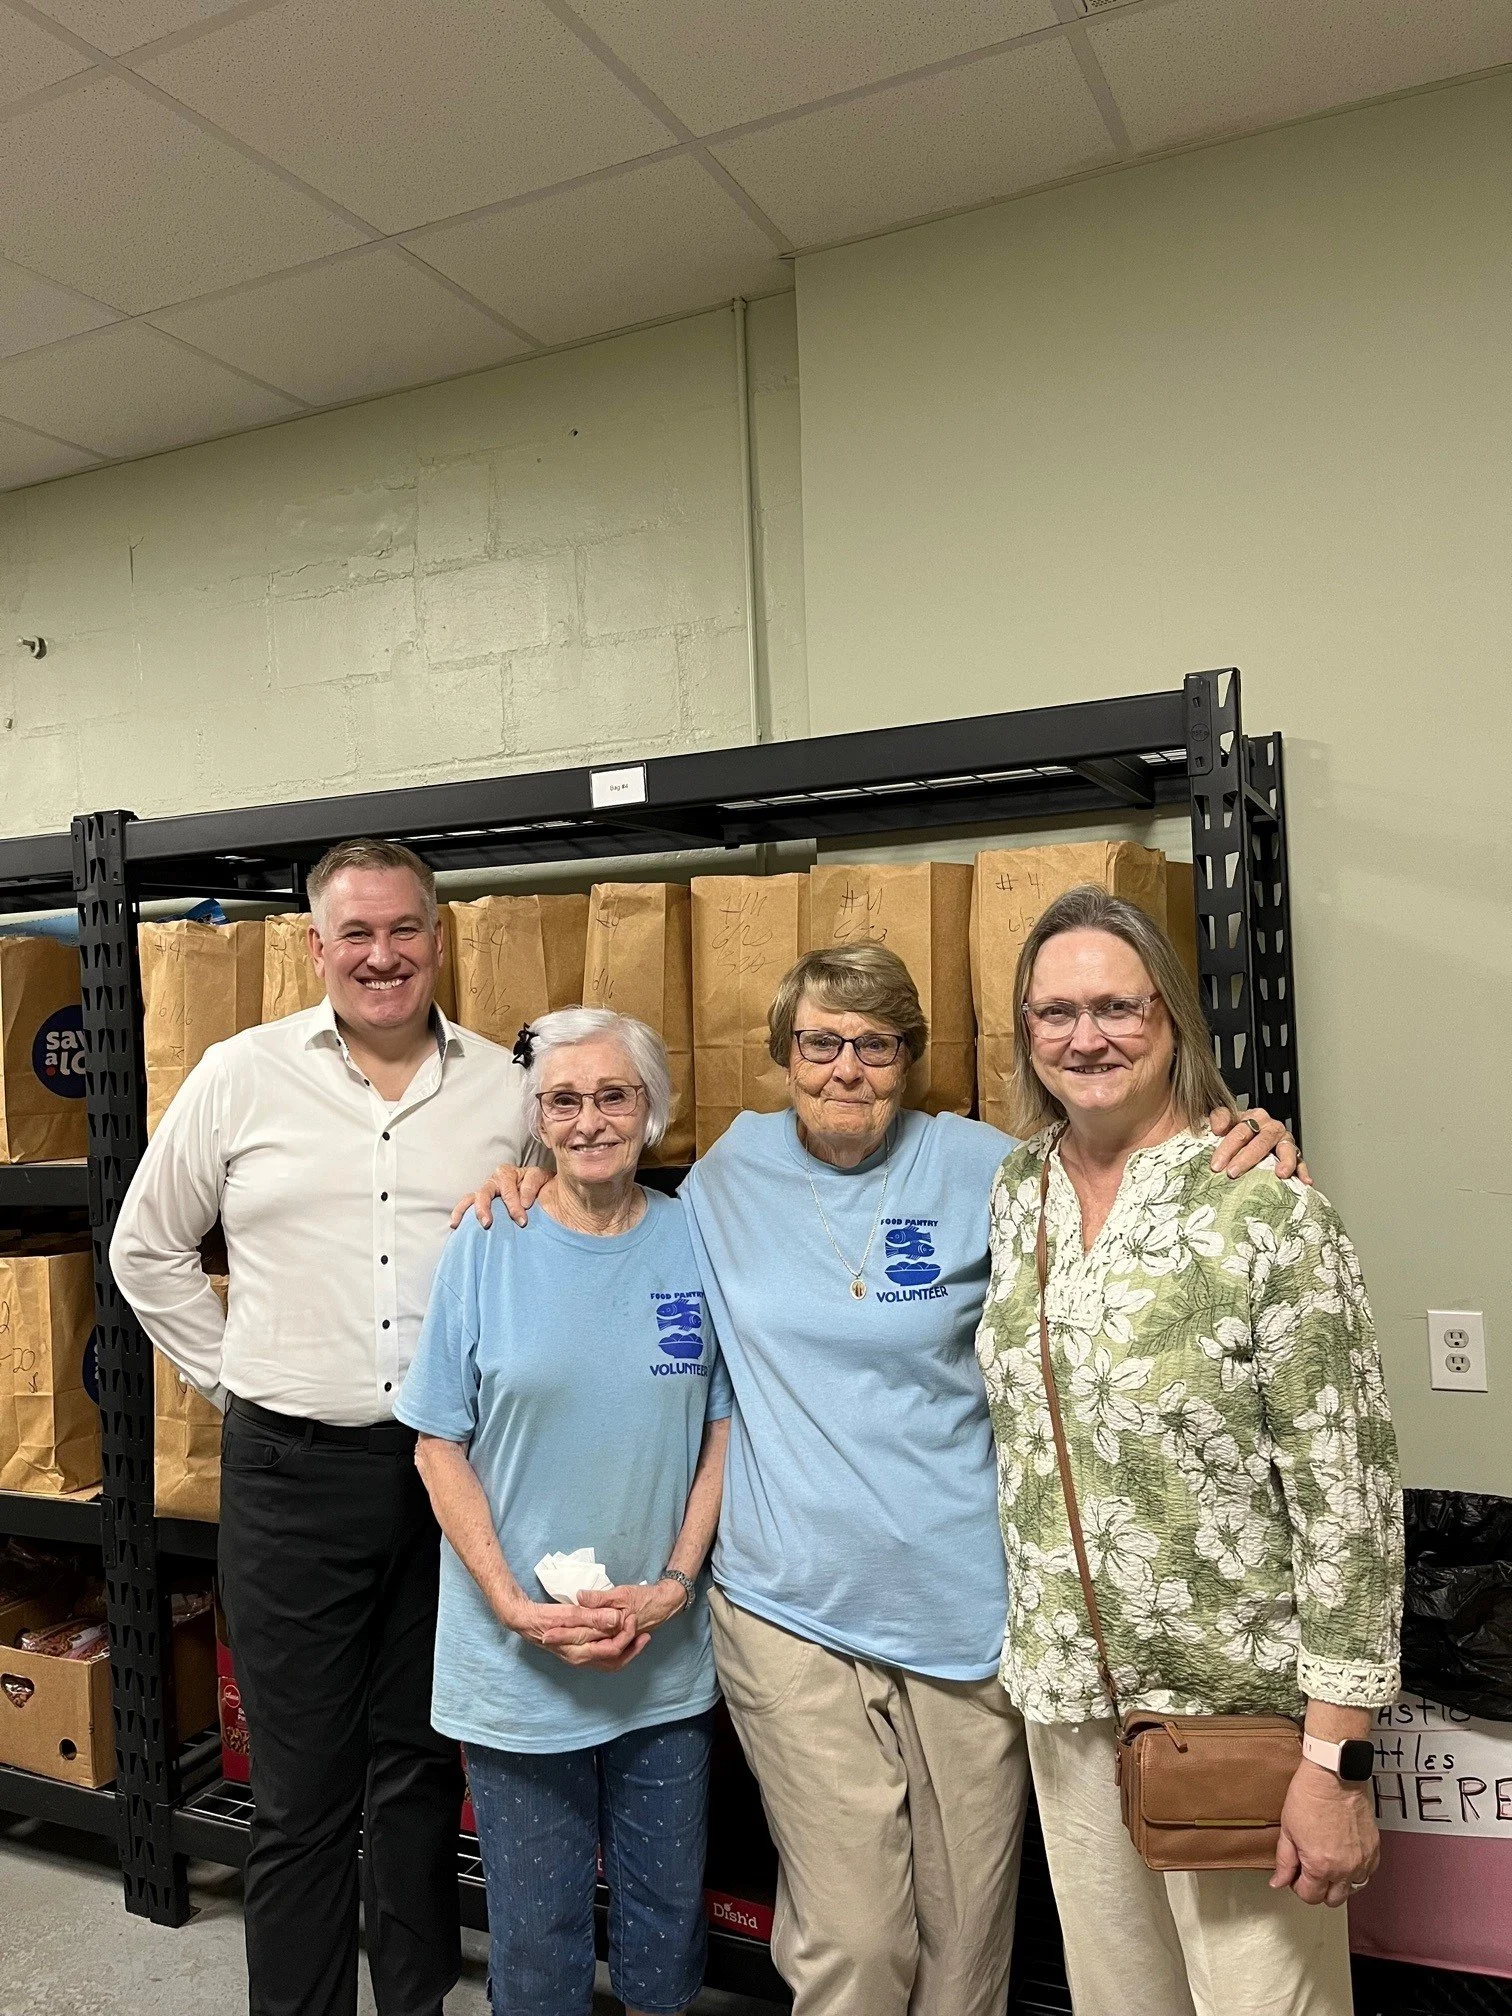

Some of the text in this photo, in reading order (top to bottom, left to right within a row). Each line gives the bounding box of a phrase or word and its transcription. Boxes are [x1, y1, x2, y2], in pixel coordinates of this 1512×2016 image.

[45, 1031, 86, 1050] sav
[880, 1218, 939, 1227] FOOD PANTRY
[650, 1292, 672, 1300] FOOD
[876, 1285, 949, 1303] VOLUNTEER
[1374, 1733, 1455, 1772] ttles
[1371, 1772, 1512, 1823] HERE
